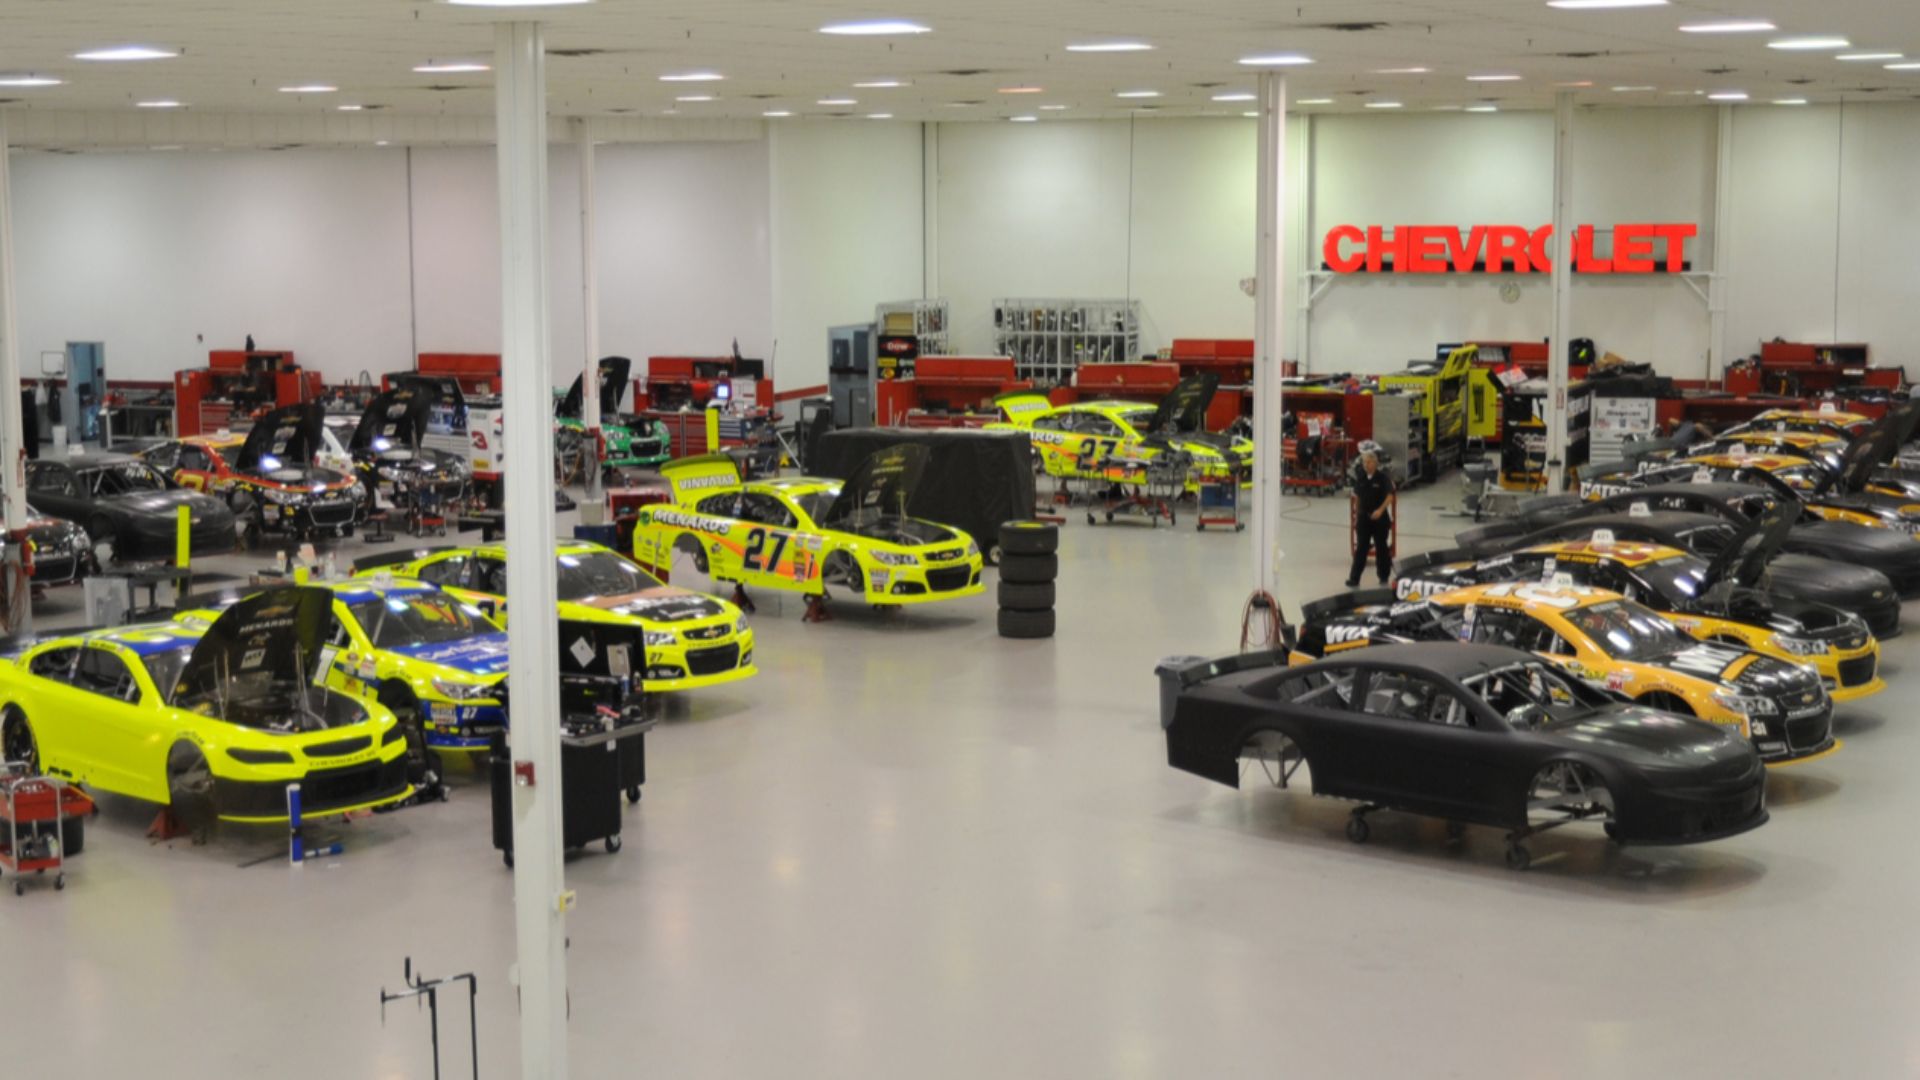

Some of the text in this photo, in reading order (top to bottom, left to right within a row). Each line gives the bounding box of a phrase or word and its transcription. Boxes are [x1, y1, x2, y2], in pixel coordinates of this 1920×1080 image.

[1322, 224, 1697, 273] CHEVROLET
[653, 509, 731, 536] MENARDS
[743, 527, 789, 574] 27
[650, 652, 664, 663] 27
